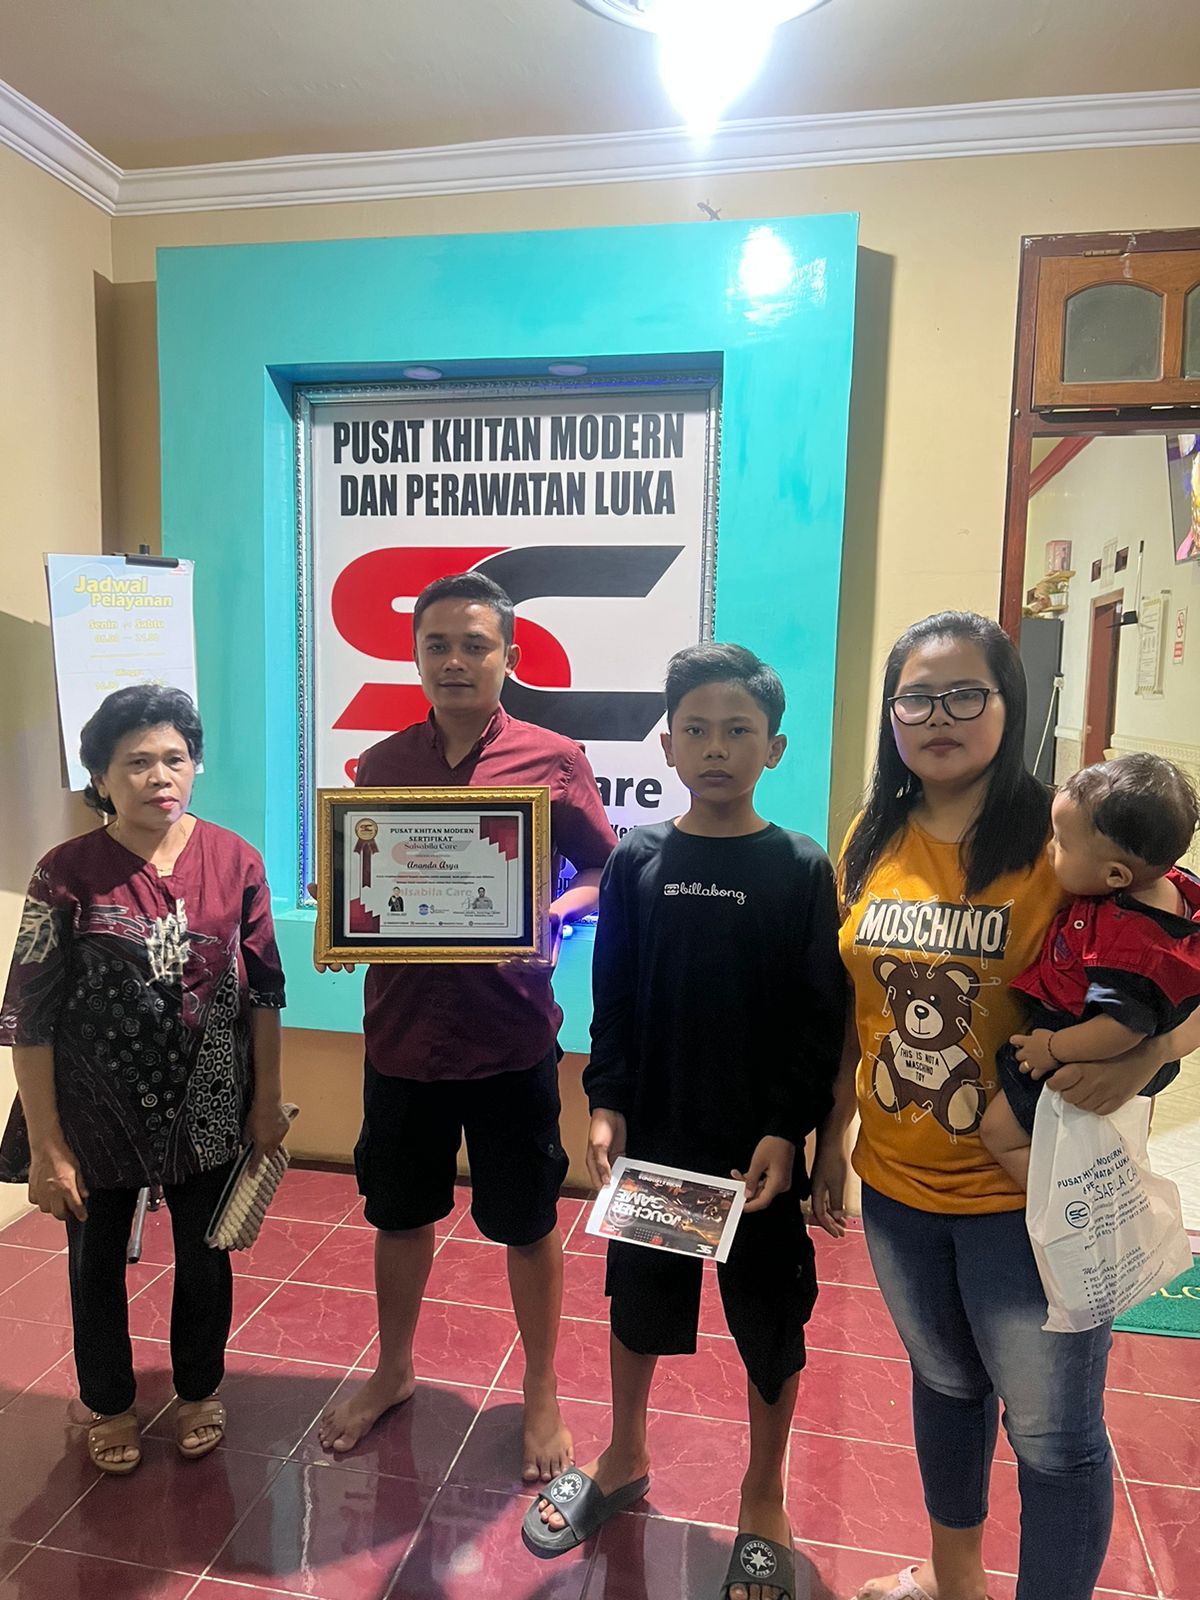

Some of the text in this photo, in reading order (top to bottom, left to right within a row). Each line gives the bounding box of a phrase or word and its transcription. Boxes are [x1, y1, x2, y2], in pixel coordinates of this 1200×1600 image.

[333, 413, 685, 464] PUSAT KHITAN MODERN
[340, 470, 676, 516] DAN PERAWATAN LUKA
[74, 575, 148, 593] Jadwal
[91, 592, 173, 611] Pelayanan
[407, 861, 437, 870] Ananda
[680, 882, 747, 905] billabong
[859, 903, 1004, 952] MOSCHINO
[901, 1048, 912, 1058] THIS
[916, 1052, 922, 1060] IS
[935, 1058, 939, 1066] A
[916, 1072, 925, 1082] TOY
[1057, 1176, 1083, 1188] PUSAT
[615, 1189, 664, 1210] GAME
[612, 1201, 682, 1226] VOUCHER
